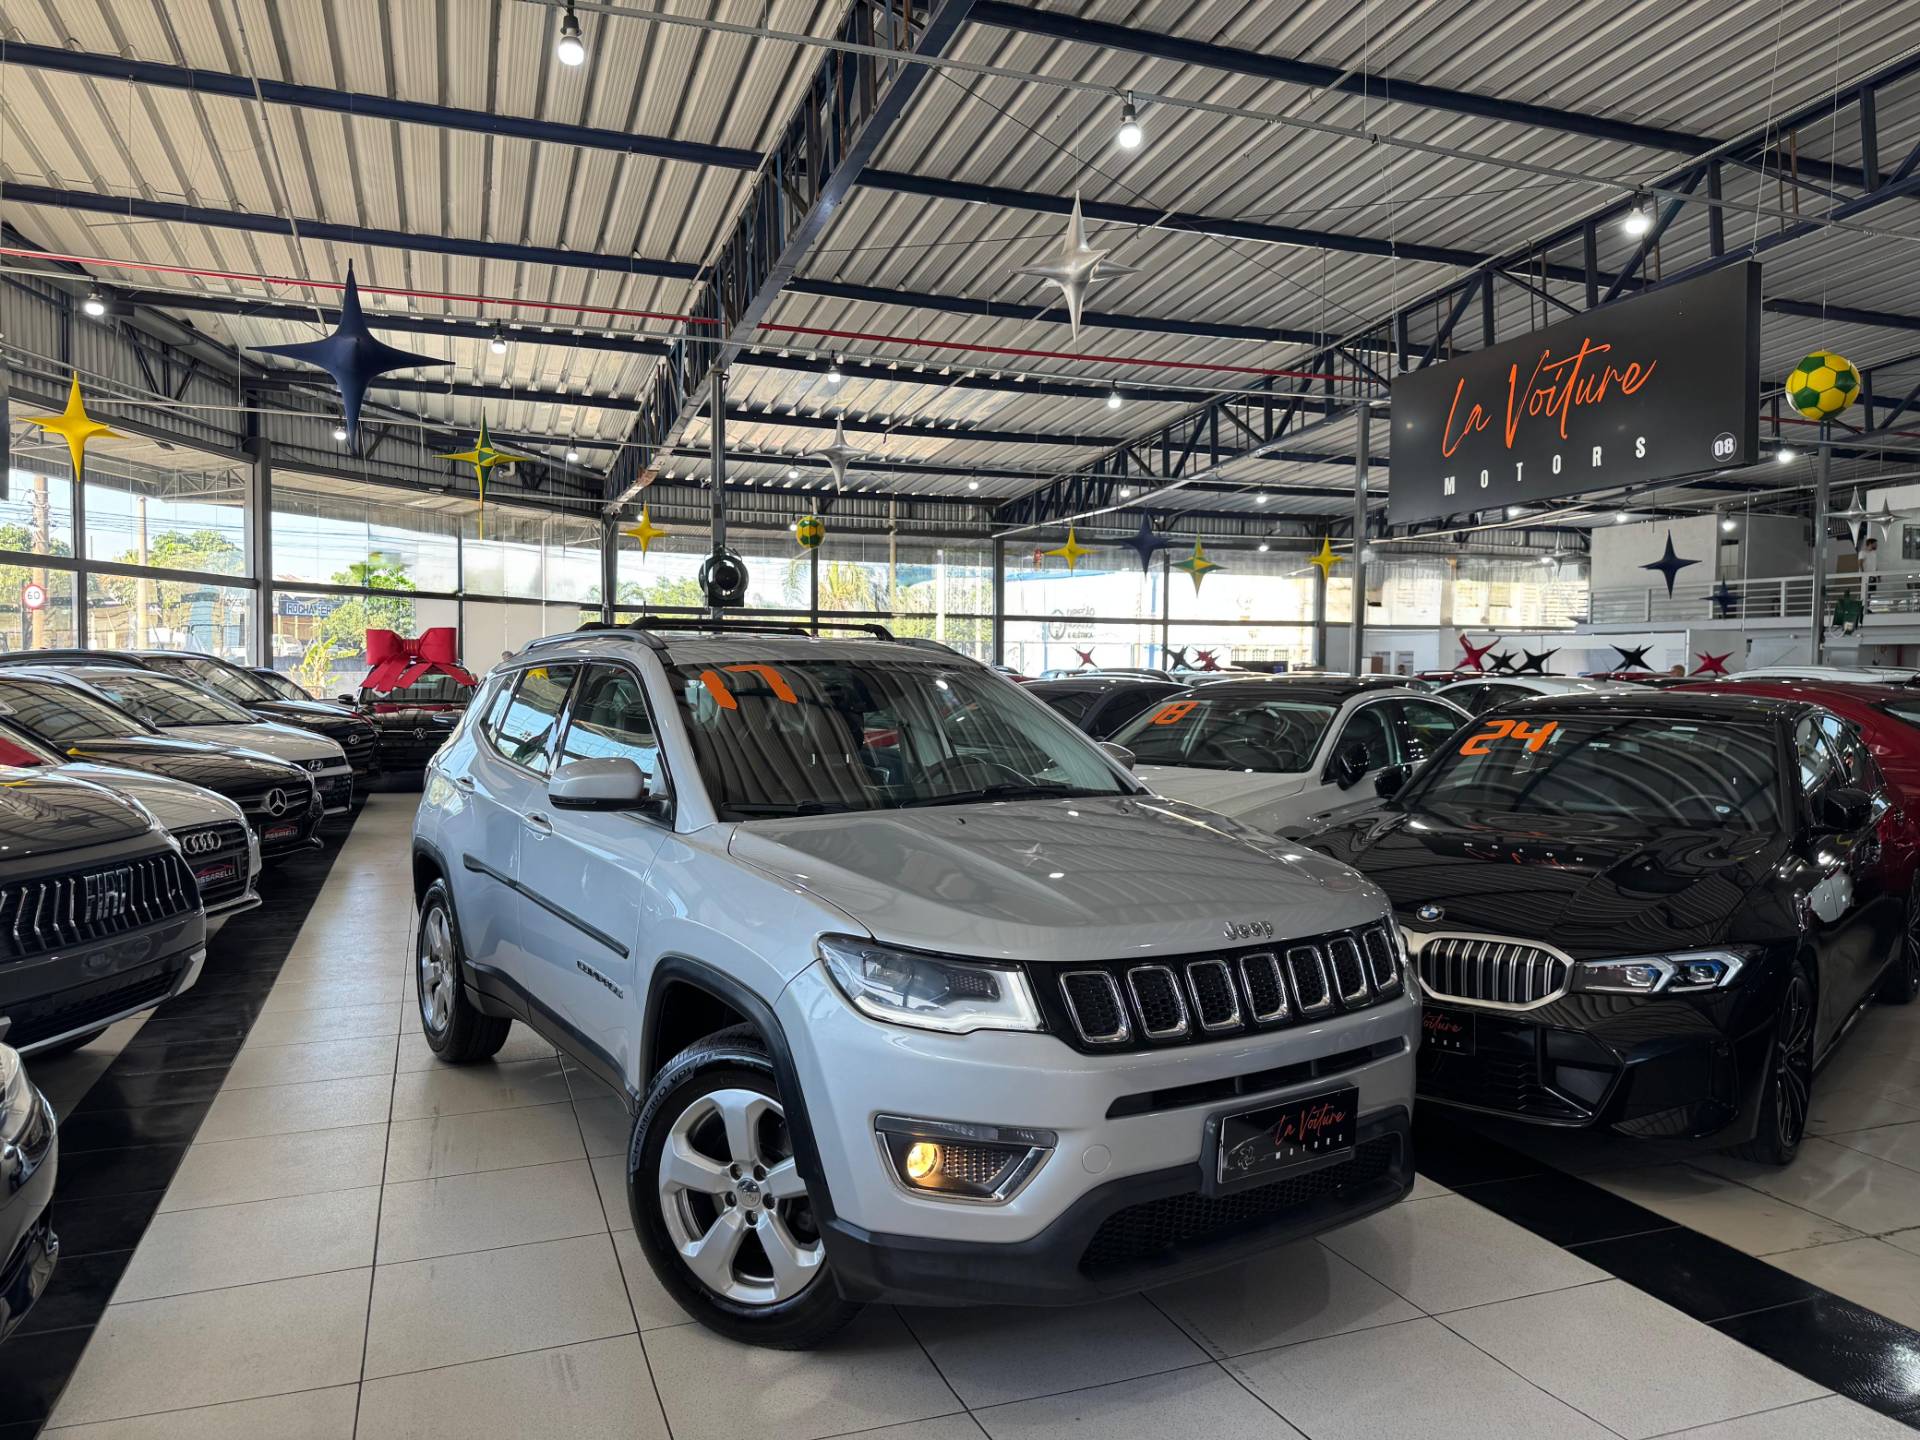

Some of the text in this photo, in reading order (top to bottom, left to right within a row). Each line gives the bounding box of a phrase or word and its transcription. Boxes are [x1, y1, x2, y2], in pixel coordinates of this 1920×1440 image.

[1442, 337, 1658, 458] La Voiture
[1443, 436, 1647, 496] MOTORS
[1713, 438, 1734, 457] 08
[286, 603, 332, 615] ROCHAER
[699, 663, 799, 711] 17
[1150, 701, 1200, 725] 18
[1459, 719, 1559, 756] 24
[83, 867, 130, 923] FIAT
[1223, 921, 1273, 941] Jeep
[1422, 1011, 1464, 1037] oiture
[1274, 1103, 1347, 1146] La Voiture
